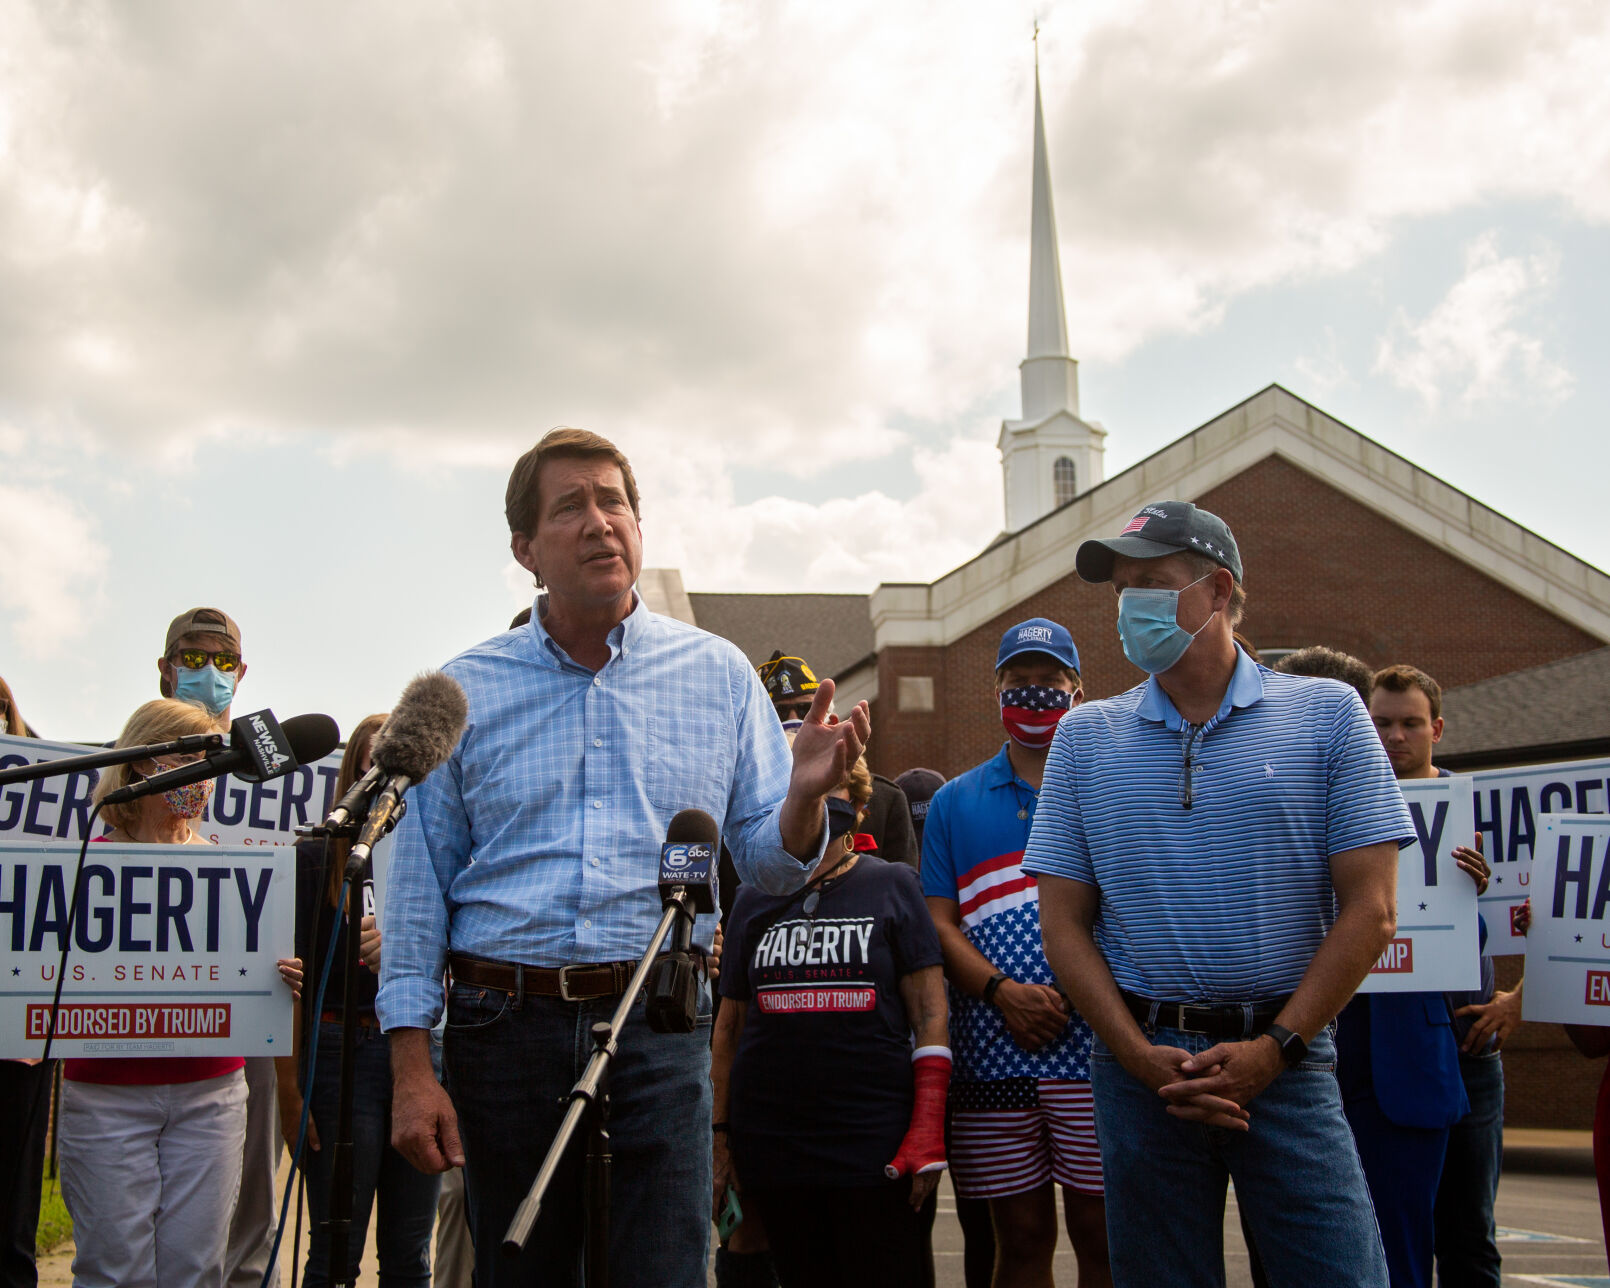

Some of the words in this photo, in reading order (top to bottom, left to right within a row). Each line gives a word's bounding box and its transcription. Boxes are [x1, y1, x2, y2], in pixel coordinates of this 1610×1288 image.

[1018, 627, 1052, 640] HAGERTY
[253, 739, 274, 775] NASHVILLE
[668, 849, 688, 866] 6
[688, 848, 710, 857] abc
[662, 871, 707, 879] WATE-TV
[0, 864, 274, 953] HAGERTY
[755, 924, 874, 969] HAGERTY
[114, 965, 220, 981] SENATE
[805, 968, 852, 979] SENATE
[761, 993, 815, 1010] ENDORSED
[817, 992, 831, 1008] BY
[832, 991, 871, 1008] TRUMP
[31, 1008, 131, 1035] ENDORSED
[135, 1008, 158, 1034] BY
[161, 1007, 227, 1034] TRUMP
